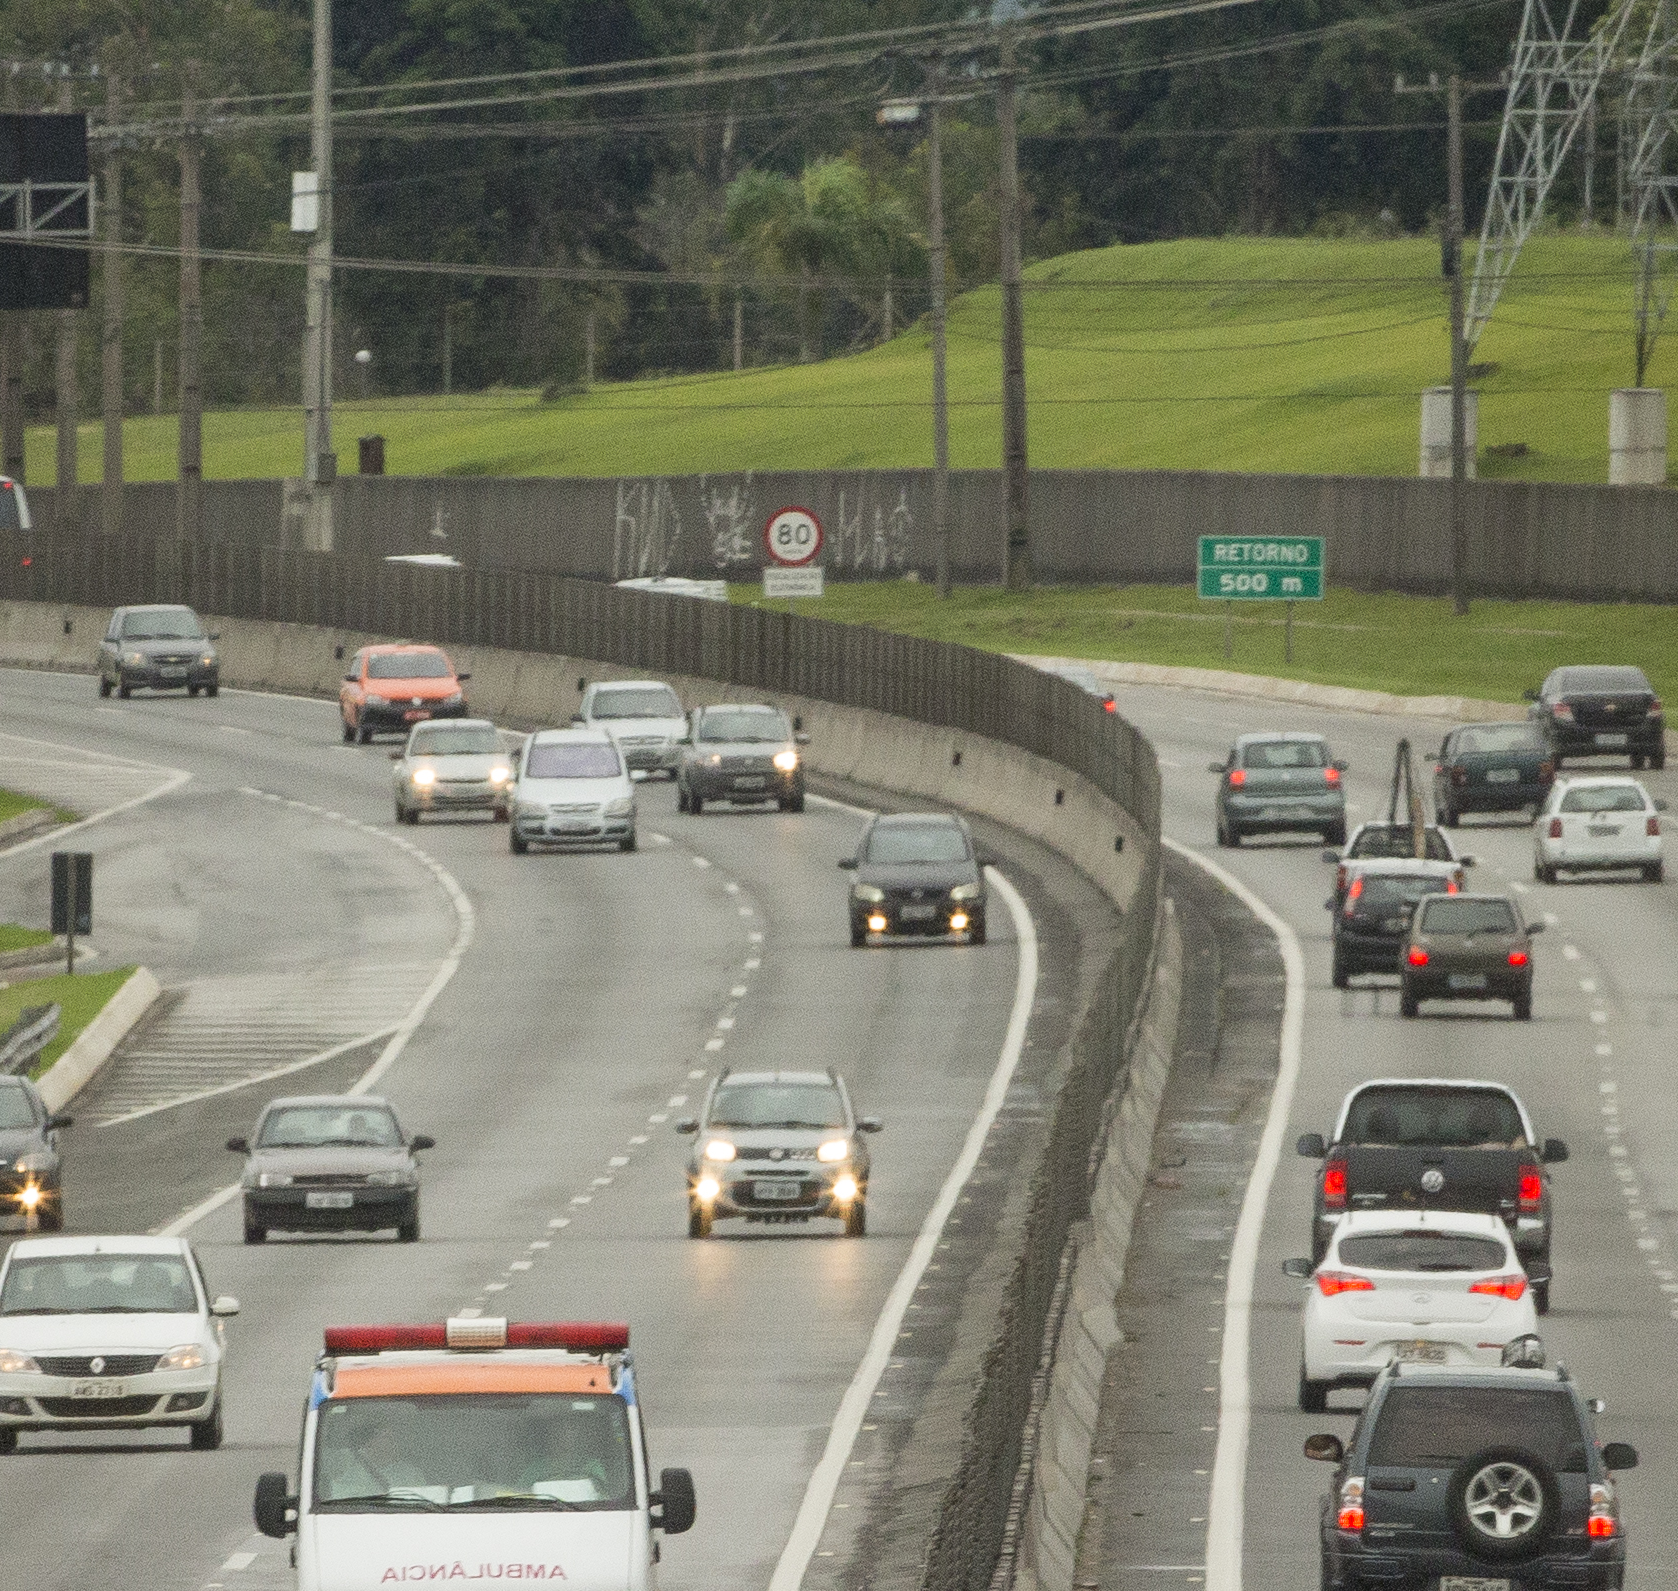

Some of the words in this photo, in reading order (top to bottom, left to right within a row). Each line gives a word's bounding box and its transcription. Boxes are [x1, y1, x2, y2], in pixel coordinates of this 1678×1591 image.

[777, 523, 811, 546] 80
[1213, 544, 1309, 562] RETORNO
[1219, 573, 1269, 592] 500
[1282, 576, 1303, 592] m
